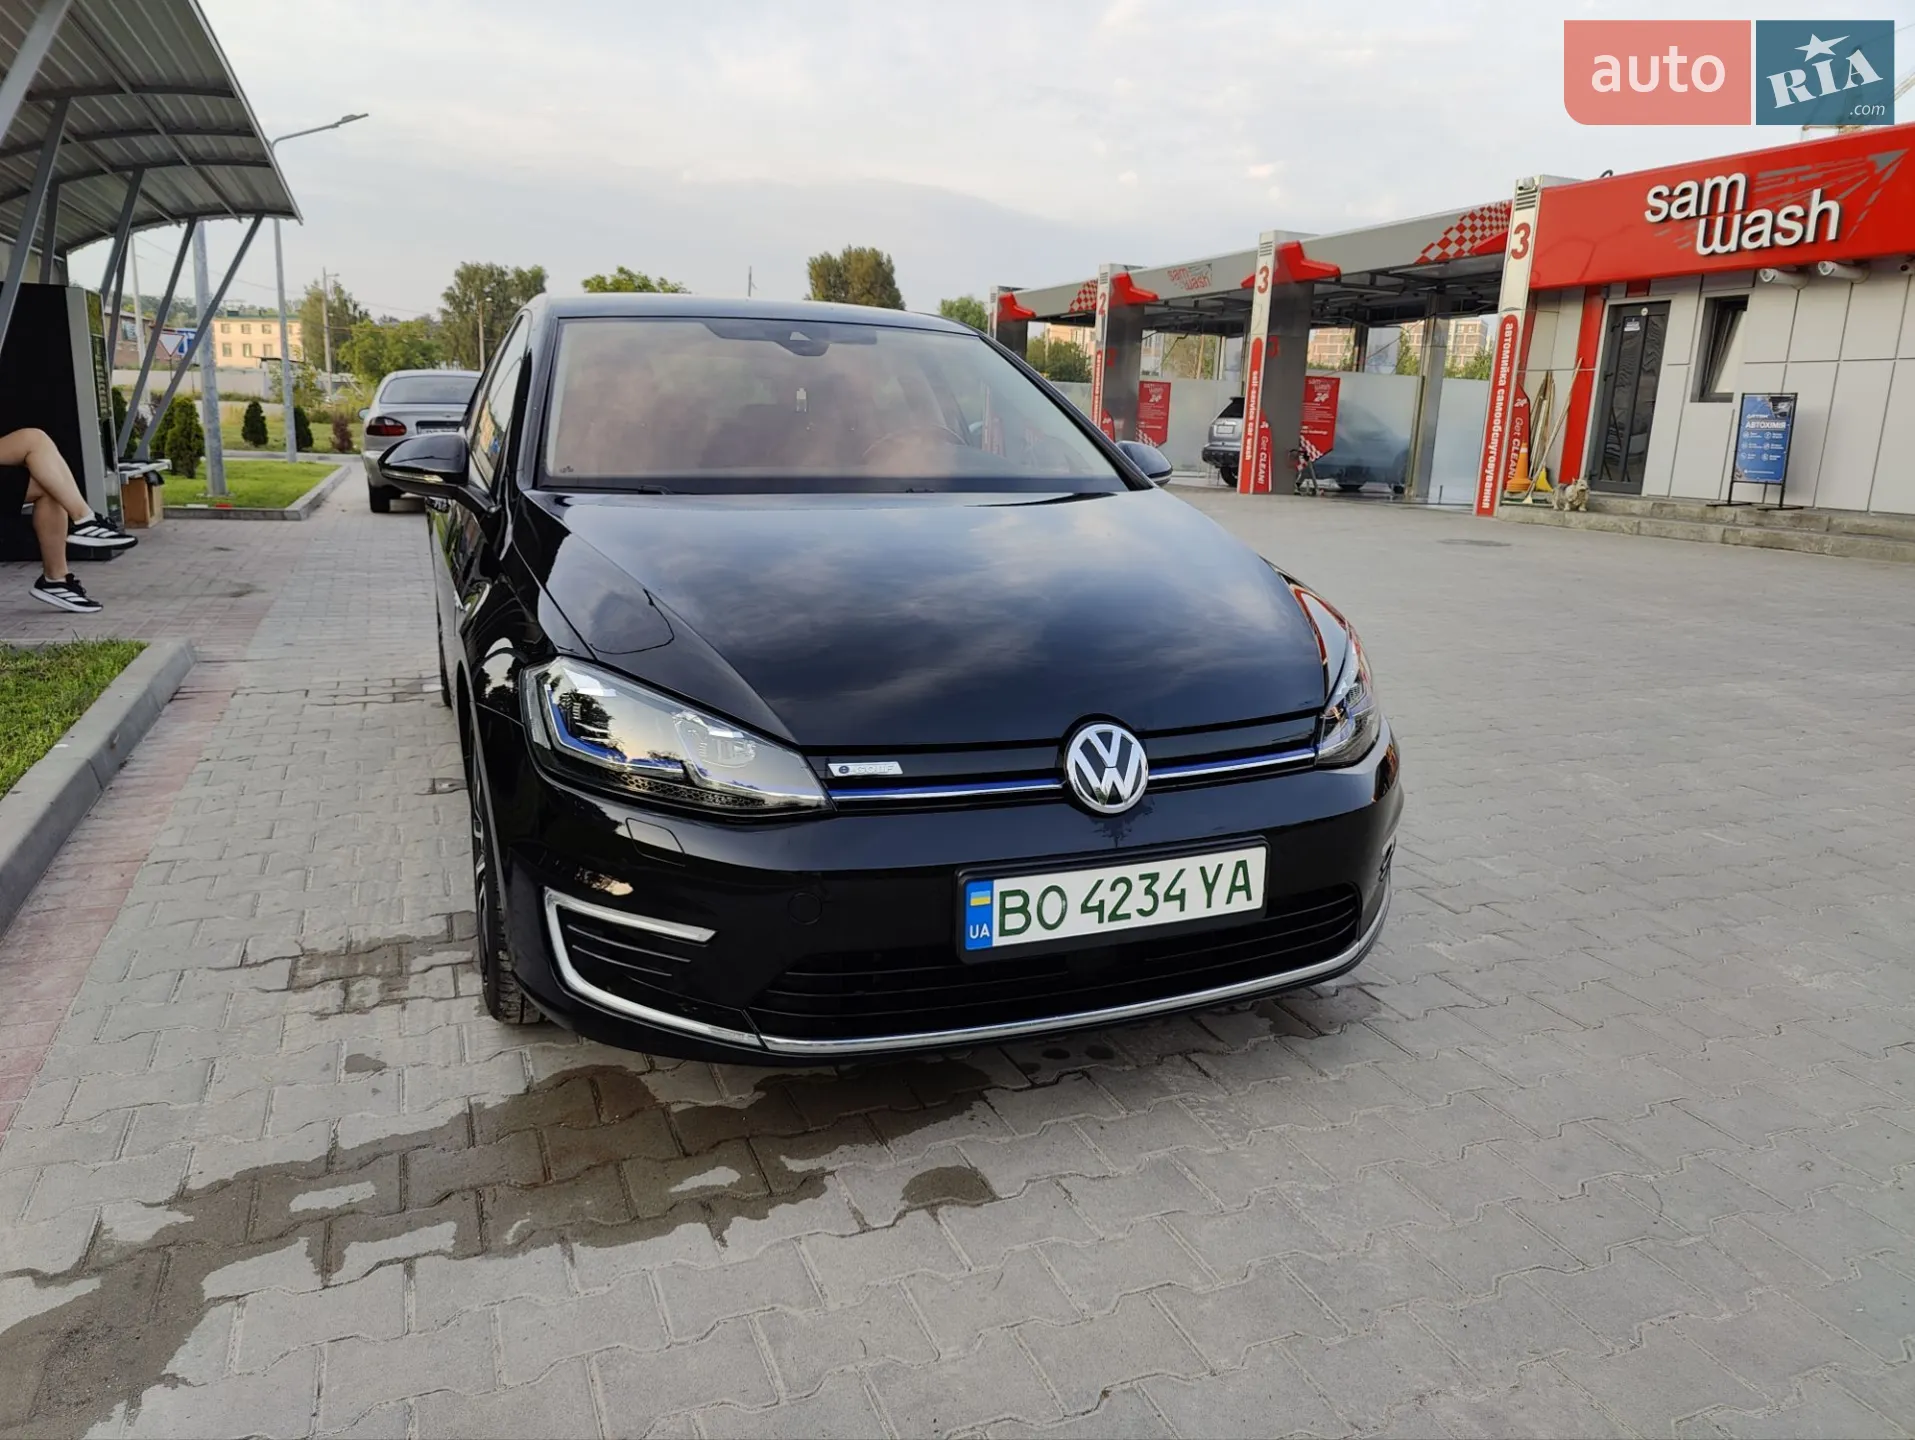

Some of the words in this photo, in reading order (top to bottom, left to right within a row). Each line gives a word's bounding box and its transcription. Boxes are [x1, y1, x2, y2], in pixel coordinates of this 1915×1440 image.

[1644, 172, 1748, 224] sam
[1510, 222, 1531, 260] 3
[1695, 188, 1841, 256] wash
[1257, 265, 1270, 294] 3
[1098, 292, 1107, 315] 2
[1080, 868, 1187, 924] 4234
[969, 924, 990, 939] UA
